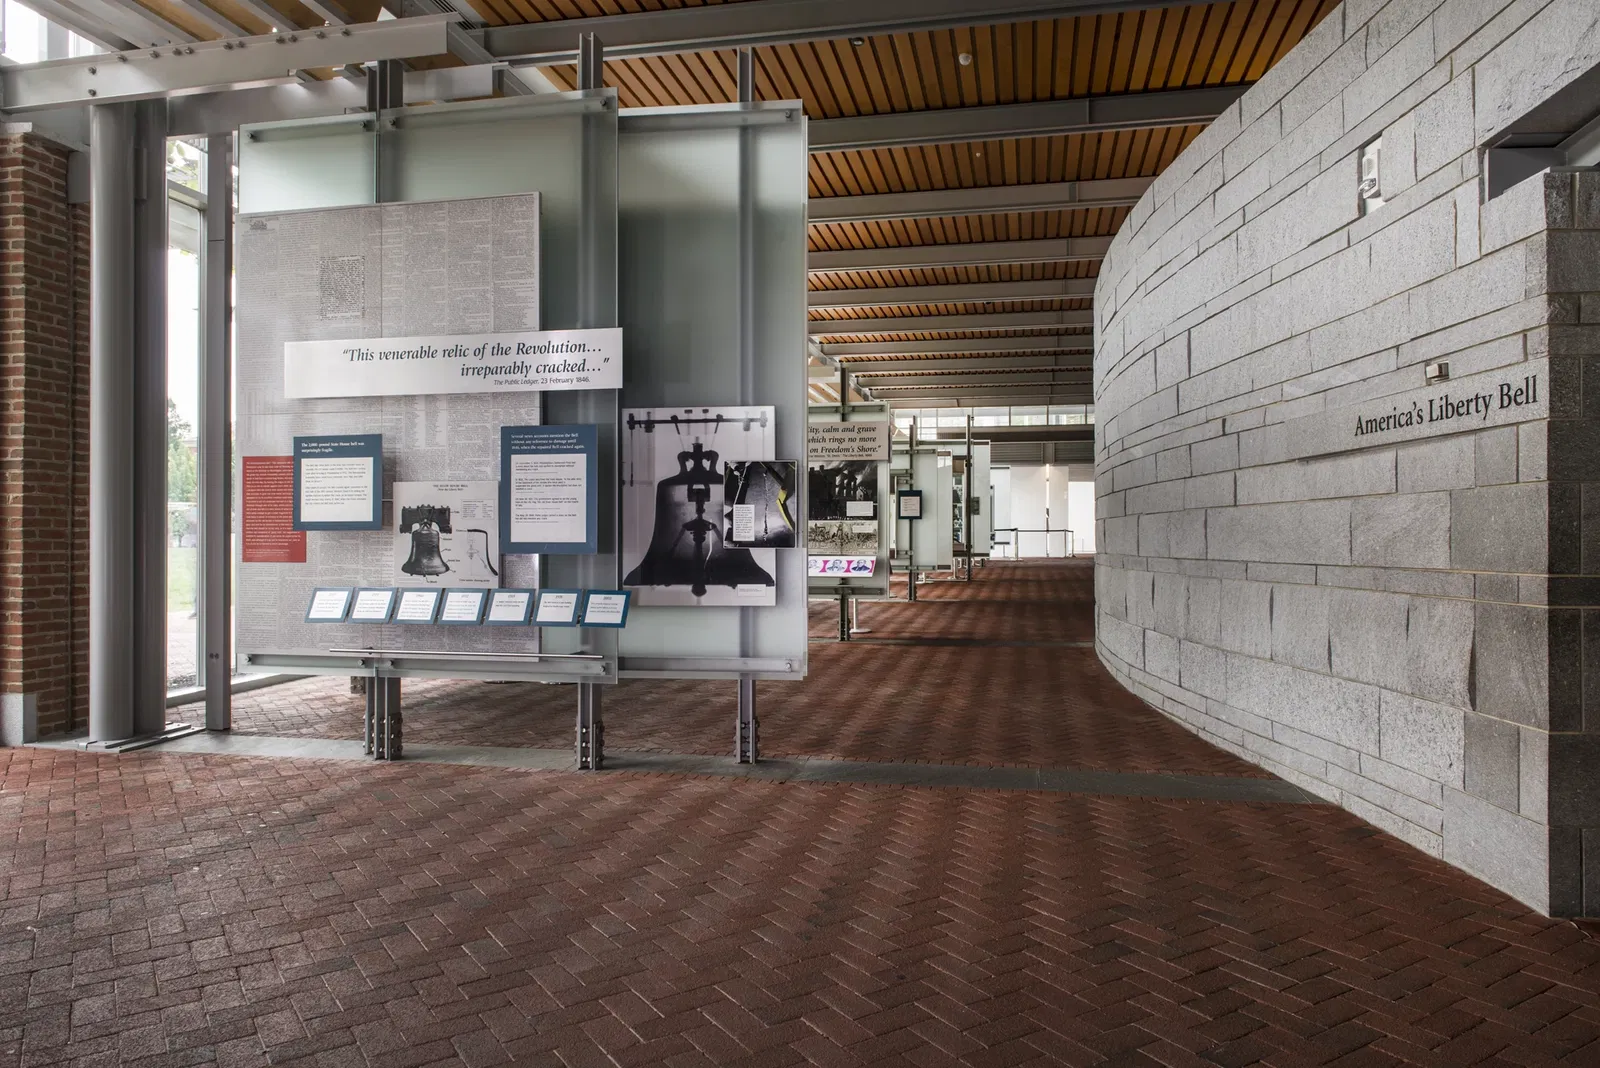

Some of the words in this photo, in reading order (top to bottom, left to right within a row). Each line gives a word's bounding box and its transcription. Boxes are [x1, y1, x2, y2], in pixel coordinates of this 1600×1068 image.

[342, 348, 374, 361] “This
[379, 346, 438, 360] venerable
[442, 344, 469, 358] relic
[473, 342, 488, 360] of
[491, 342, 511, 356] the
[461, 361, 532, 379] irreparably
[549, 377, 574, 385] February
[1428, 393, 1493, 422] Liberty
[1498, 374, 1538, 409] Bell
[808, 426, 820, 434] ity,
[829, 436, 846, 444] rings
